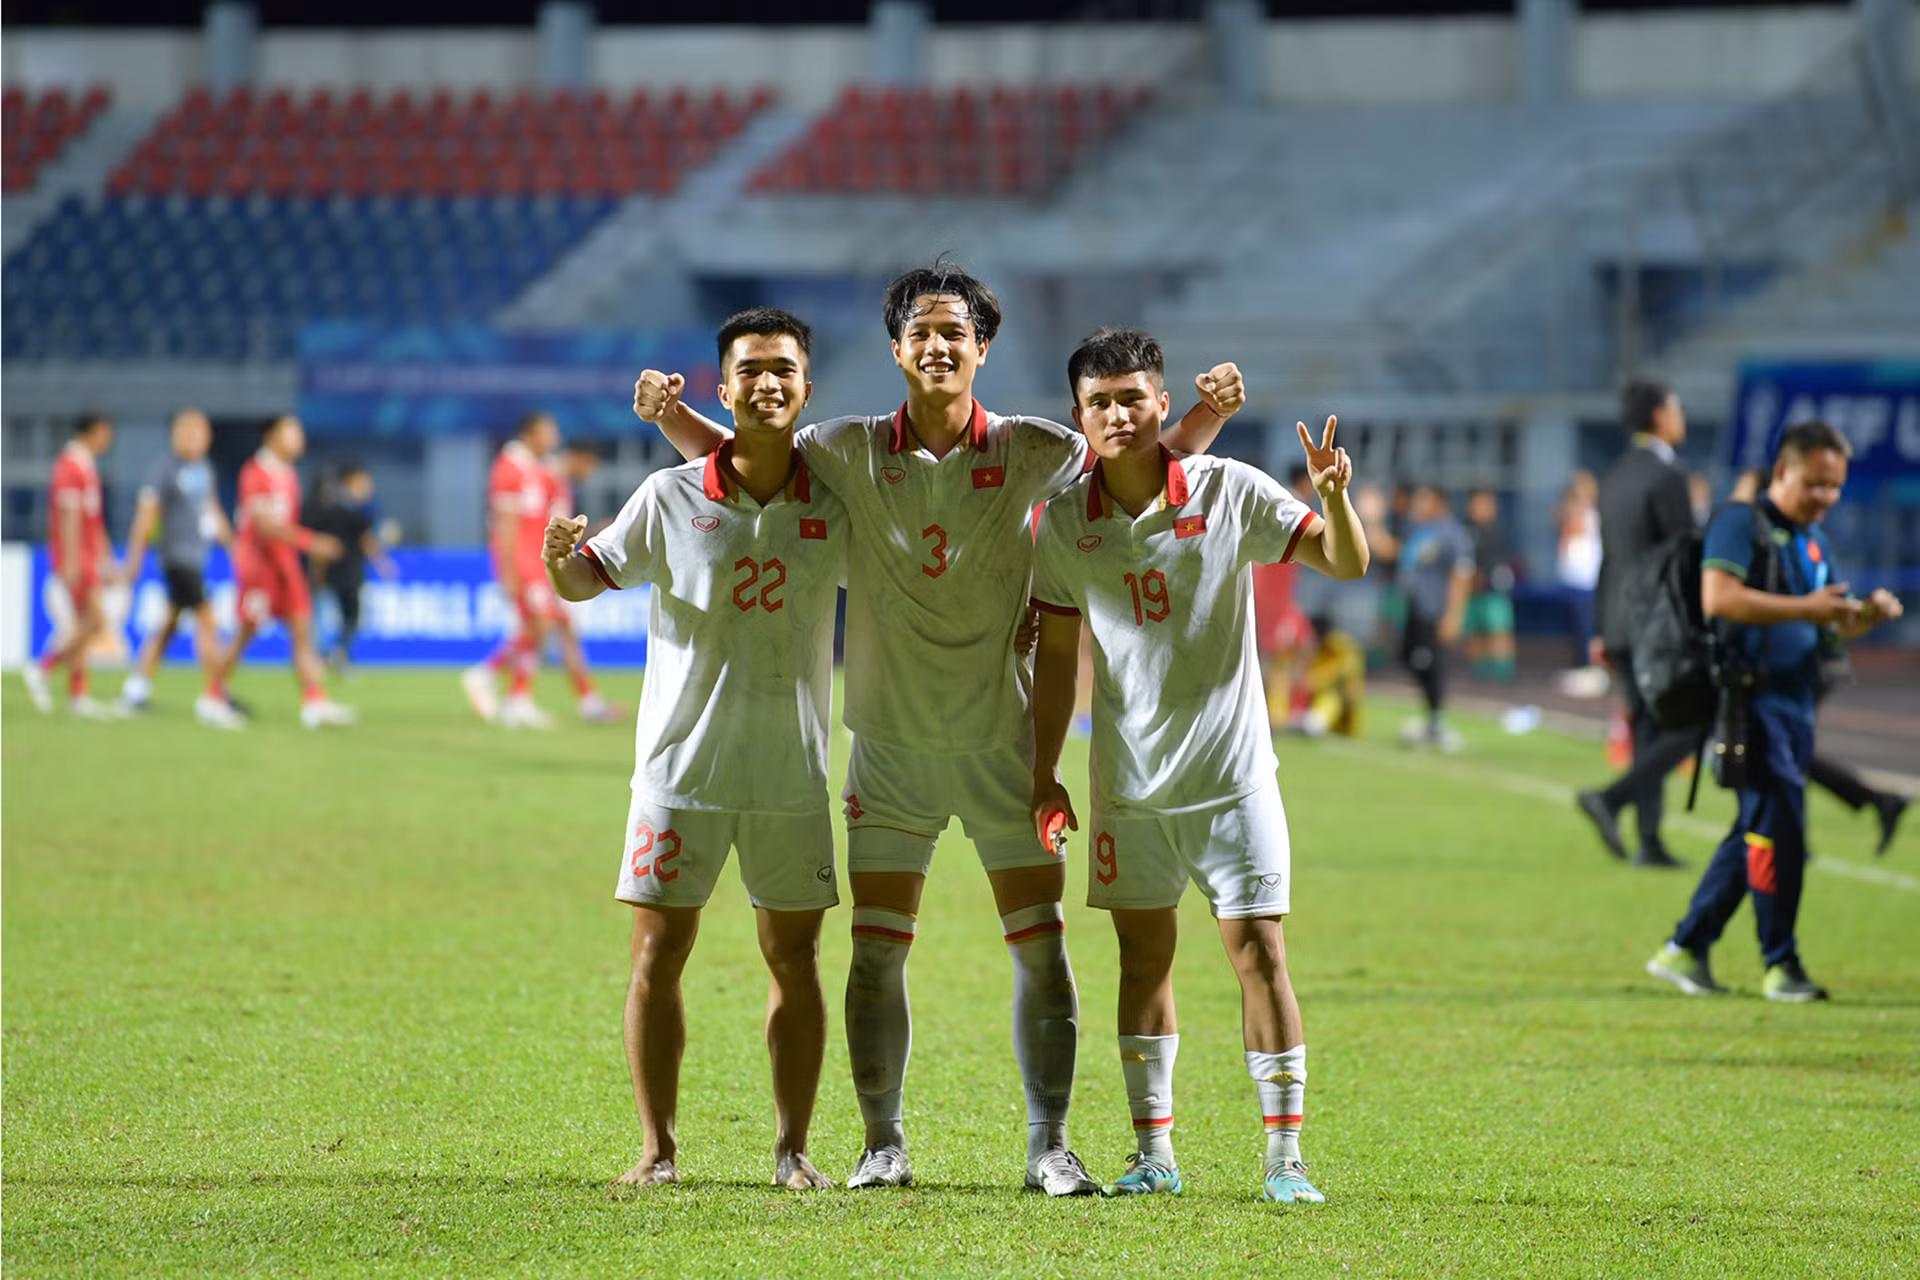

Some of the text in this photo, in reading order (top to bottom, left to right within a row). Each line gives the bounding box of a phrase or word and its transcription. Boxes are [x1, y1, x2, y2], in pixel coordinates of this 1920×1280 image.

[922, 524, 947, 579] 3
[733, 556, 787, 614] 22
[1123, 568, 1171, 626] 19
[631, 822, 682, 883] 22
